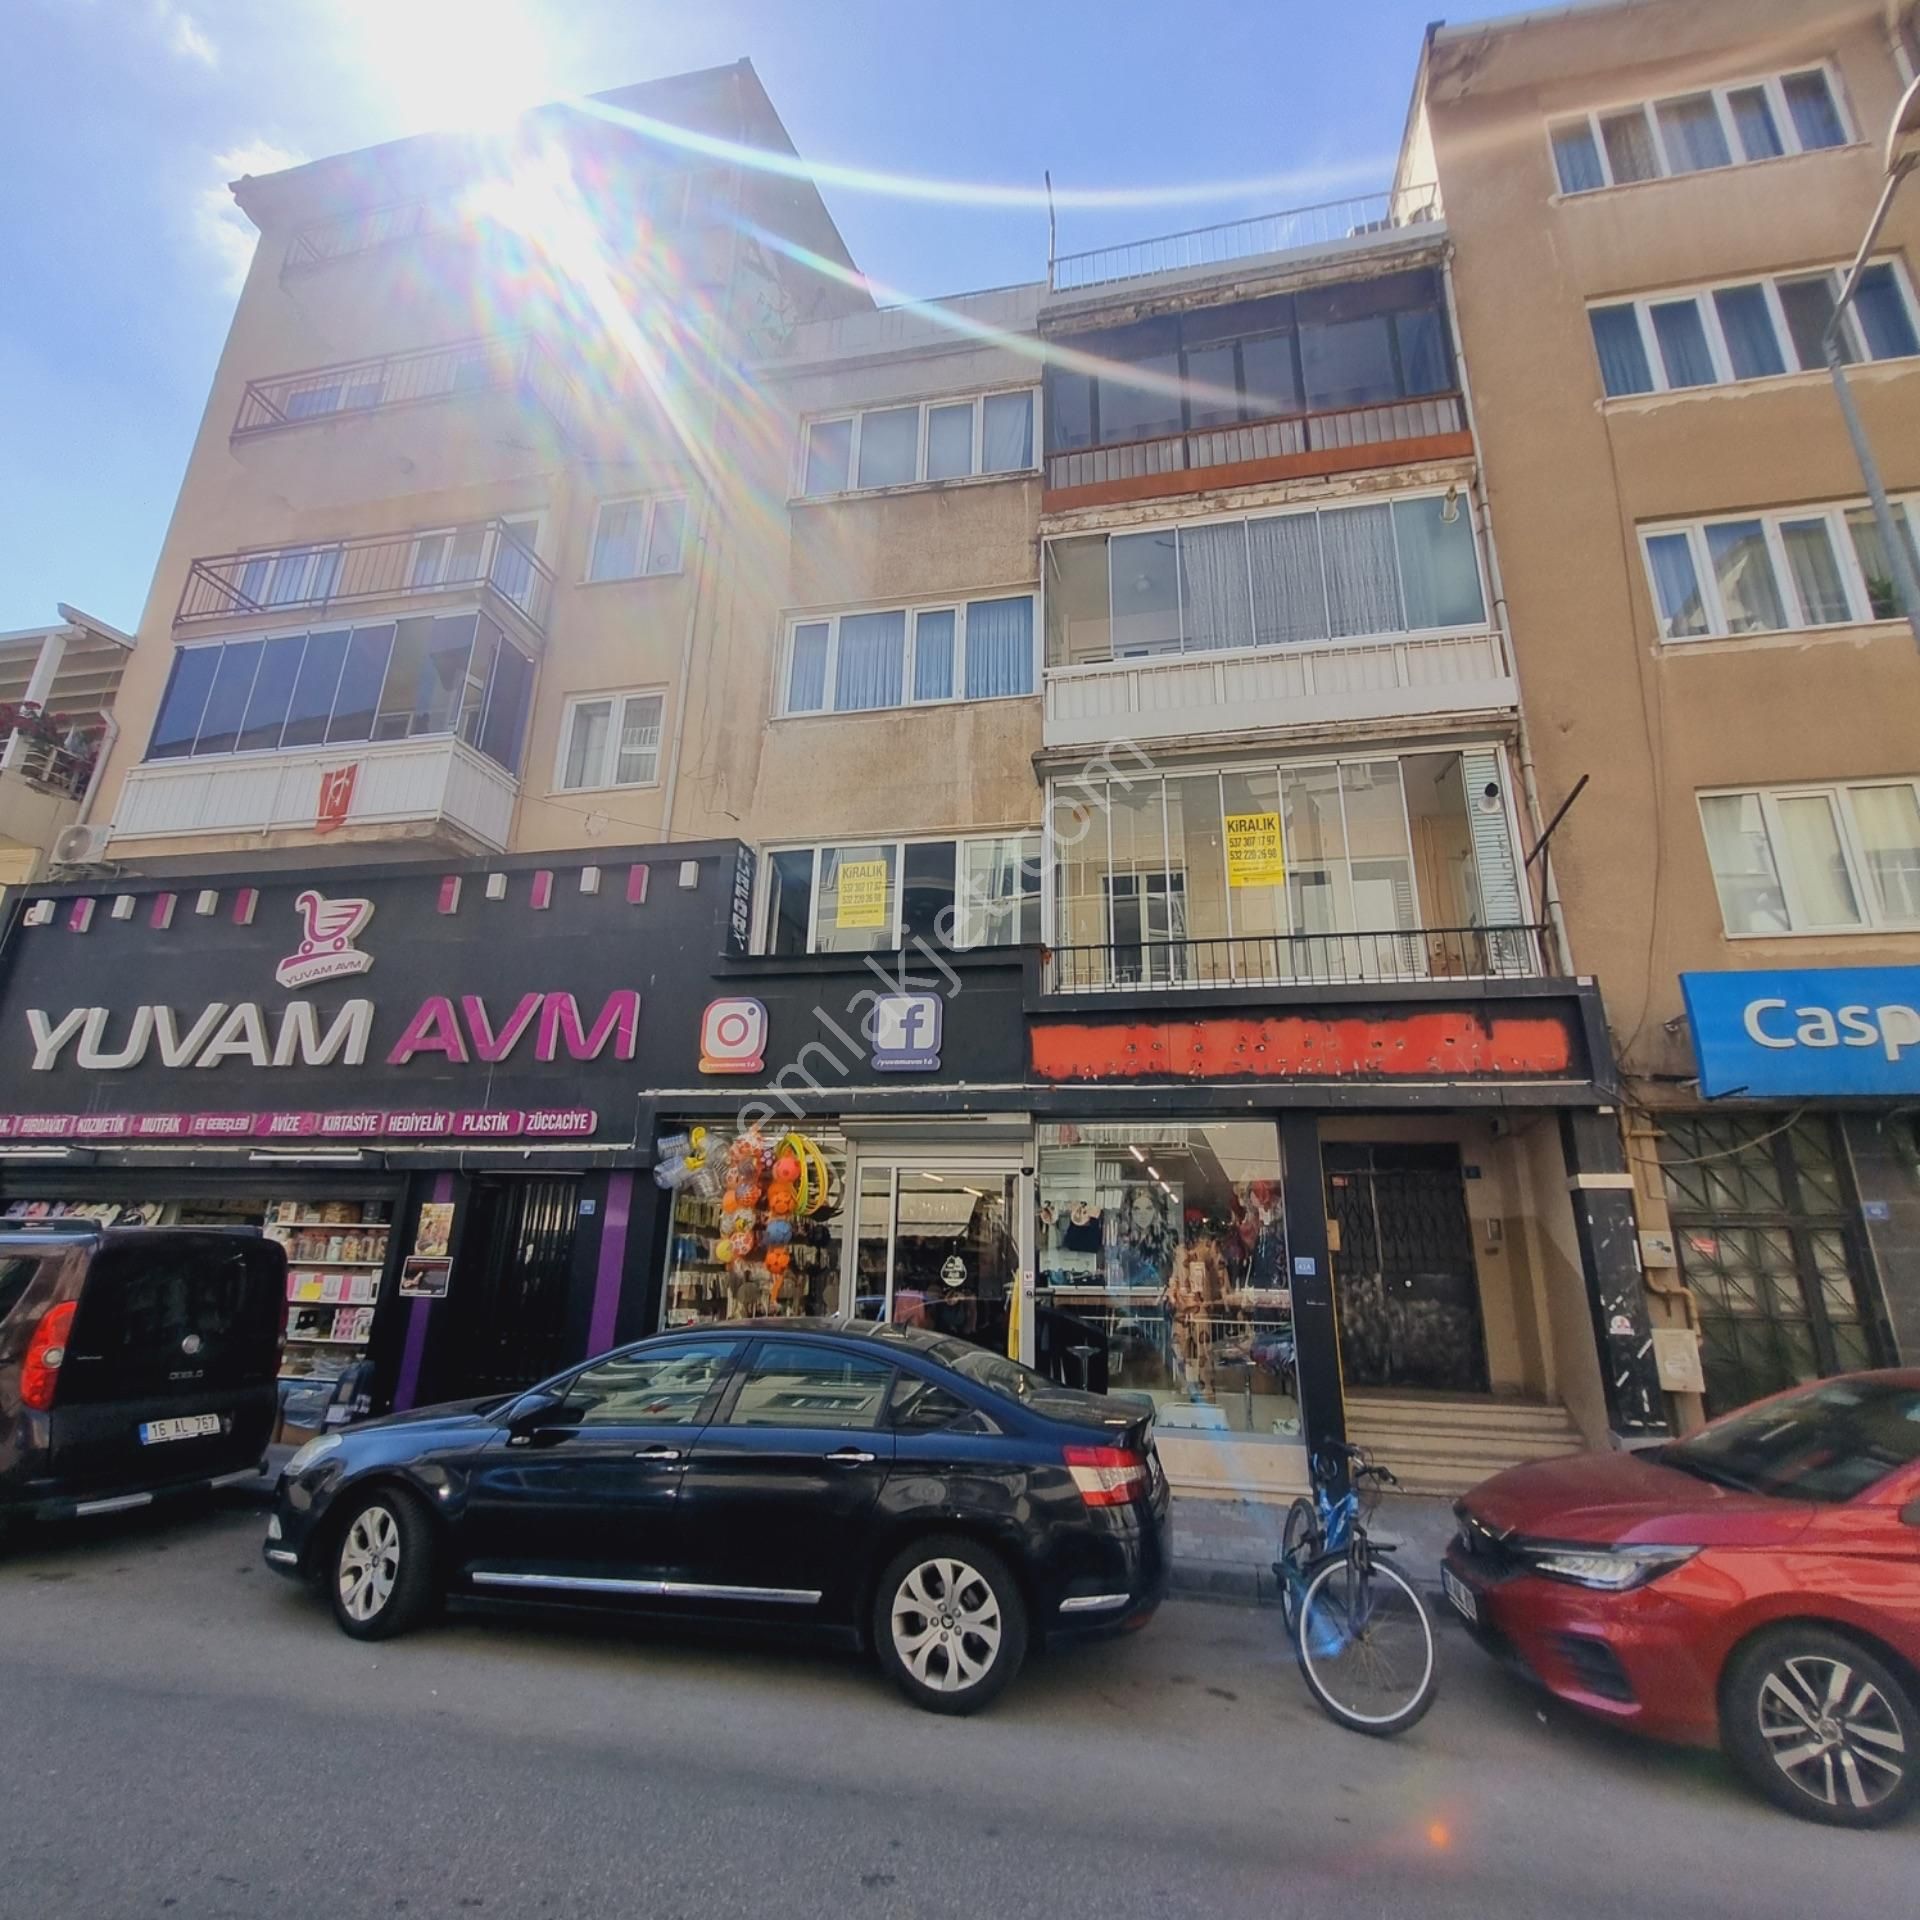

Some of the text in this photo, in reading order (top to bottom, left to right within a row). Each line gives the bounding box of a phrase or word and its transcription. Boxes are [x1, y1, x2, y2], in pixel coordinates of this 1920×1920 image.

[286, 960, 362, 984] YUVAM AVM
[26, 990, 641, 1070] YUVAM AVM
[139, 1117, 181, 1133] MUTFAK
[270, 1113, 300, 1132] AVİZE
[322, 1113, 378, 1132] KIRTASİYE
[388, 1112, 445, 1132] HEDİYELİK
[462, 1111, 510, 1131] PLASTİK
[526, 1112, 588, 1131] ZÜCCACİYE
[151, 1422, 167, 1437] 16
